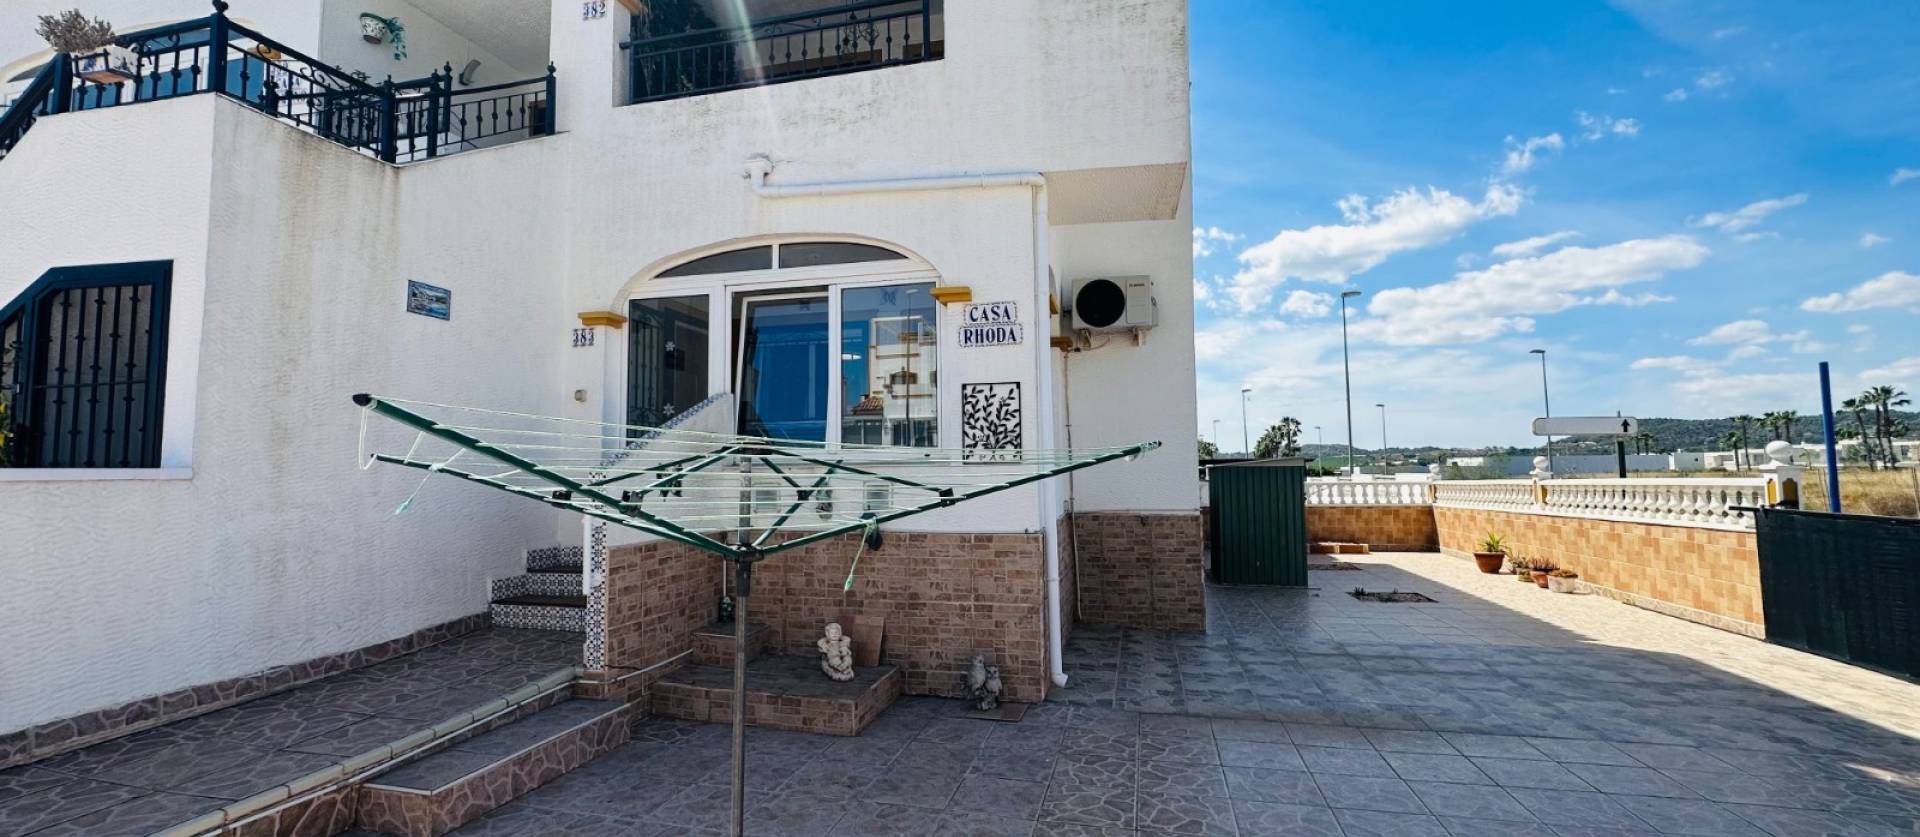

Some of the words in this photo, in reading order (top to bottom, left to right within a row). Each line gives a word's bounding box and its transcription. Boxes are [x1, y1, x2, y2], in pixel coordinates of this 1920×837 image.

[969, 305, 1011, 322] CASA
[572, 329, 595, 346] 383
[964, 327, 1017, 344] RHODA
